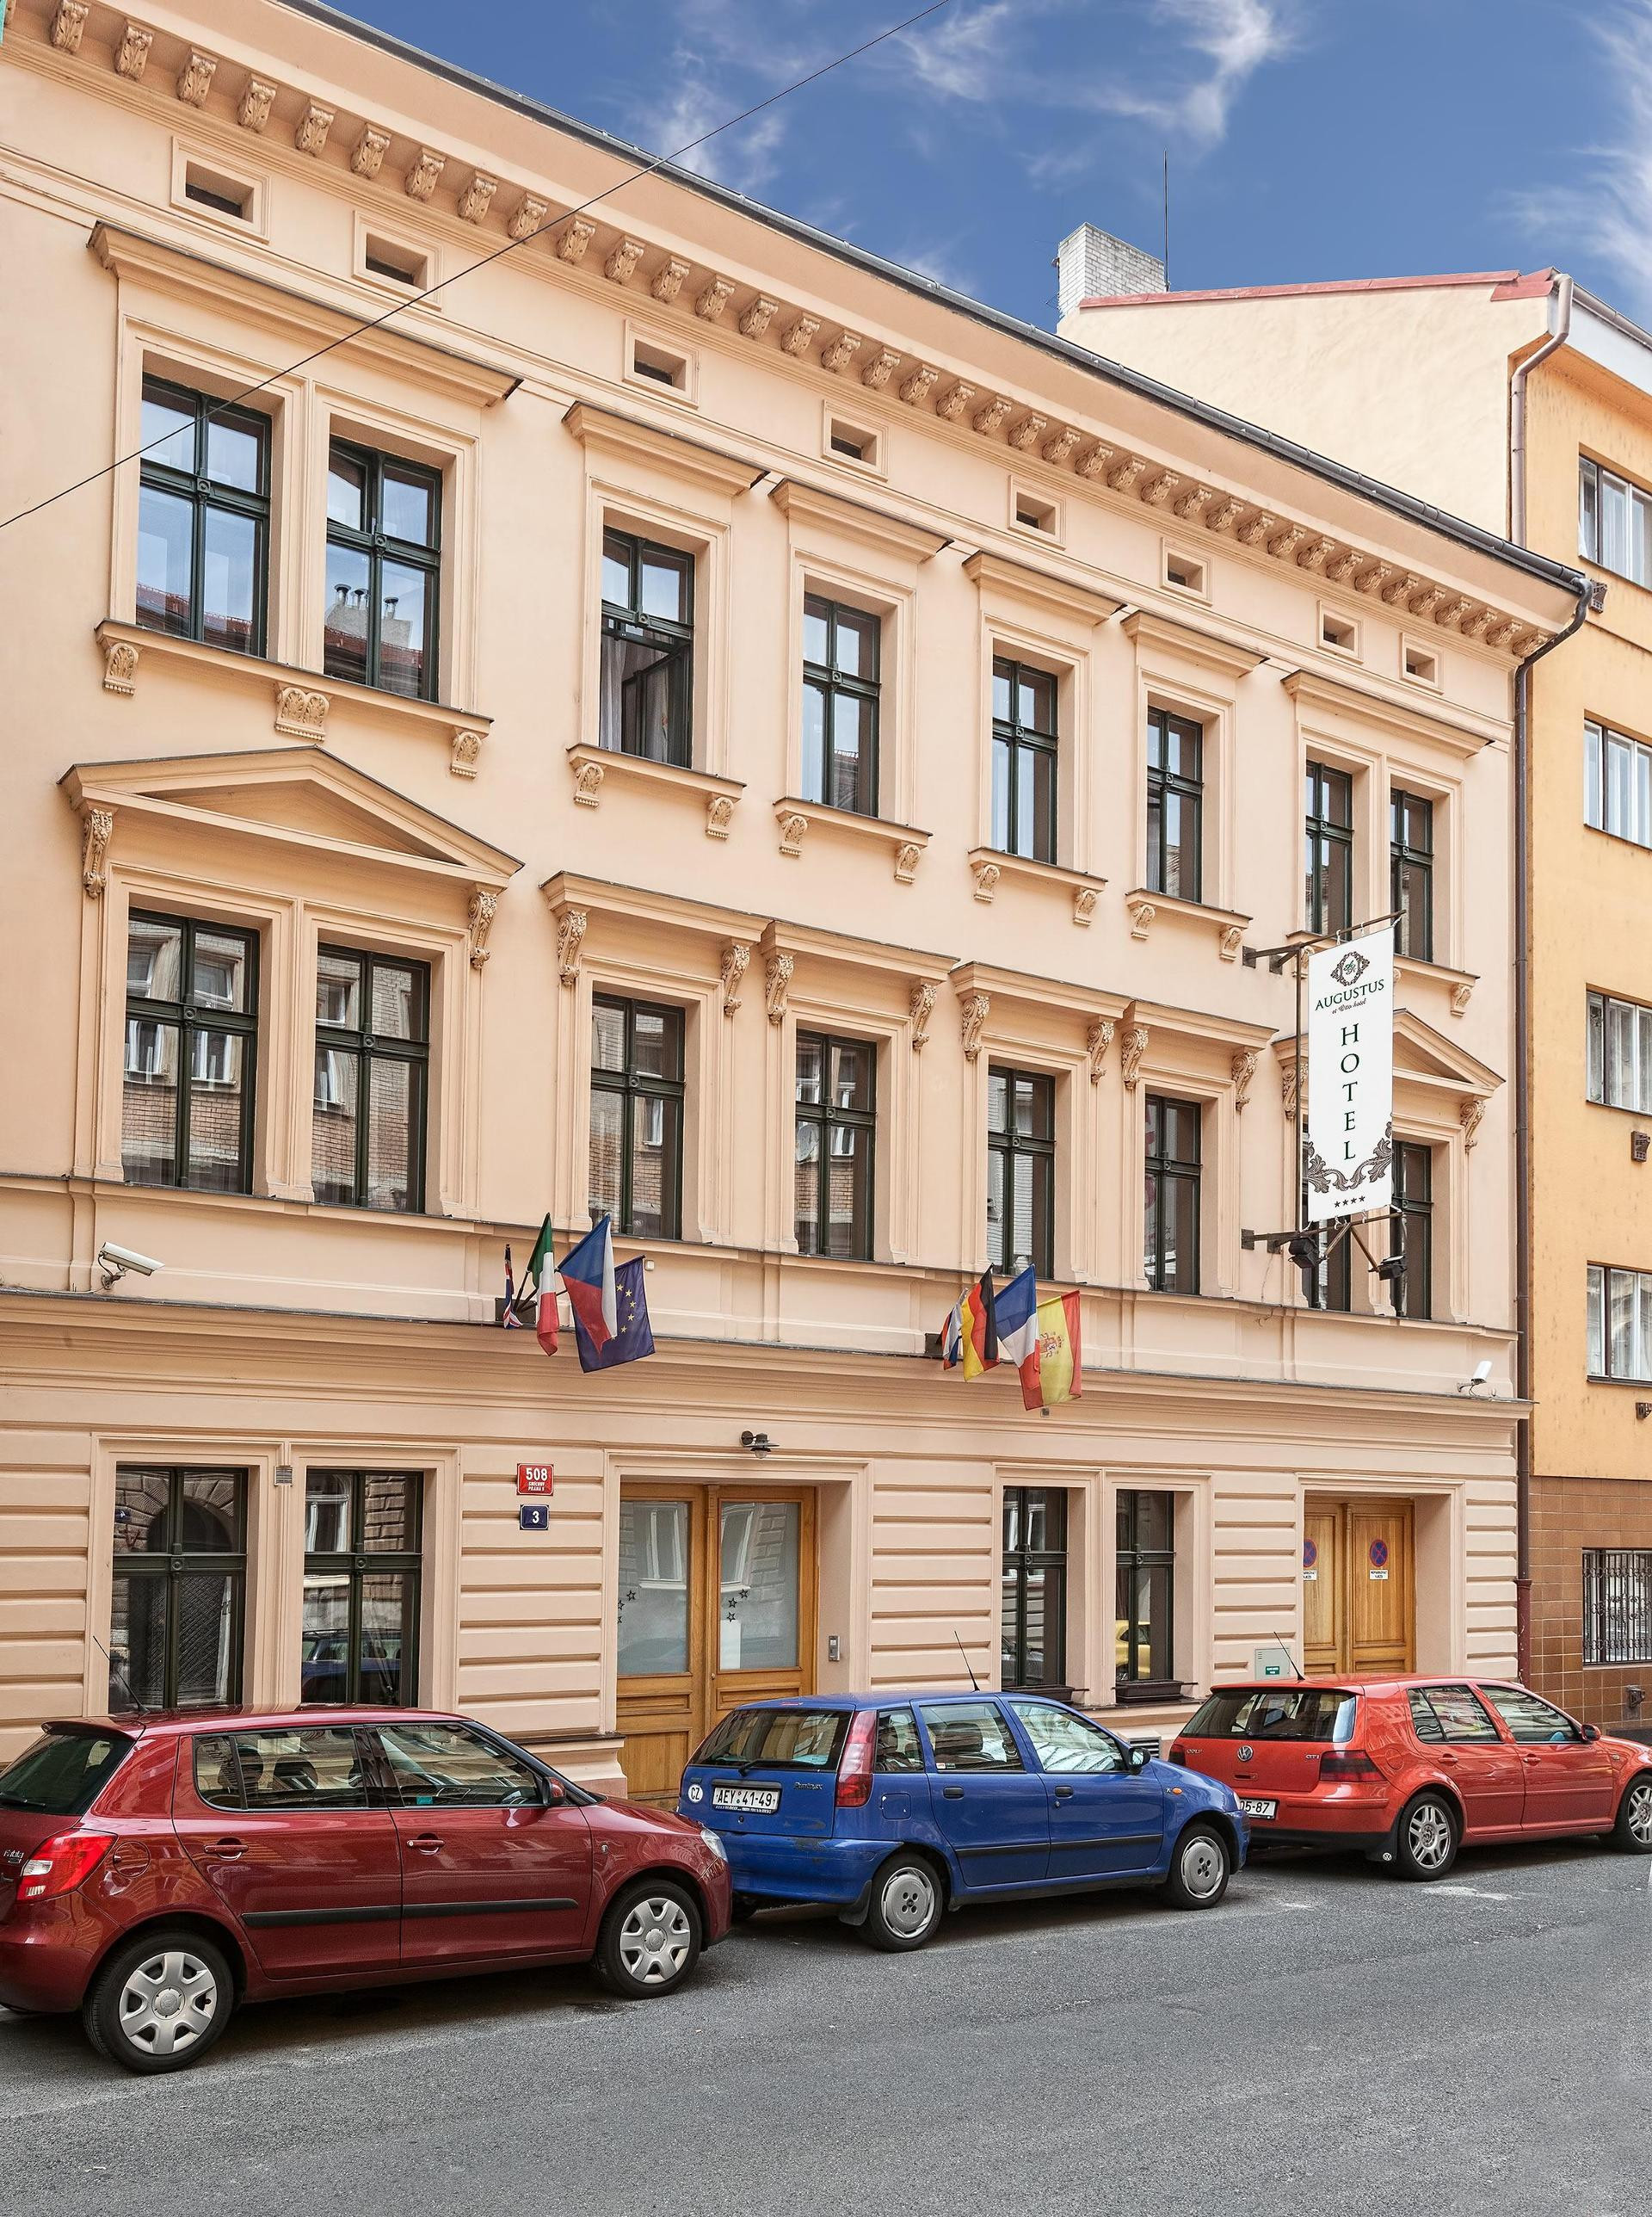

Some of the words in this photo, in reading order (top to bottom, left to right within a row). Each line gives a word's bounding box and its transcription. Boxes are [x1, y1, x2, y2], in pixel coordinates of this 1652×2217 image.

[1315, 979, 1384, 1011] AUGUSTUS
[1340, 1022, 1360, 1161] HOTEL
[526, 1467, 548, 1480] 508
[532, 1510, 539, 1523] 3
[691, 1787, 700, 1800] CZ
[718, 1789, 736, 1804] AEY
[742, 1791, 773, 1806] 41-49
